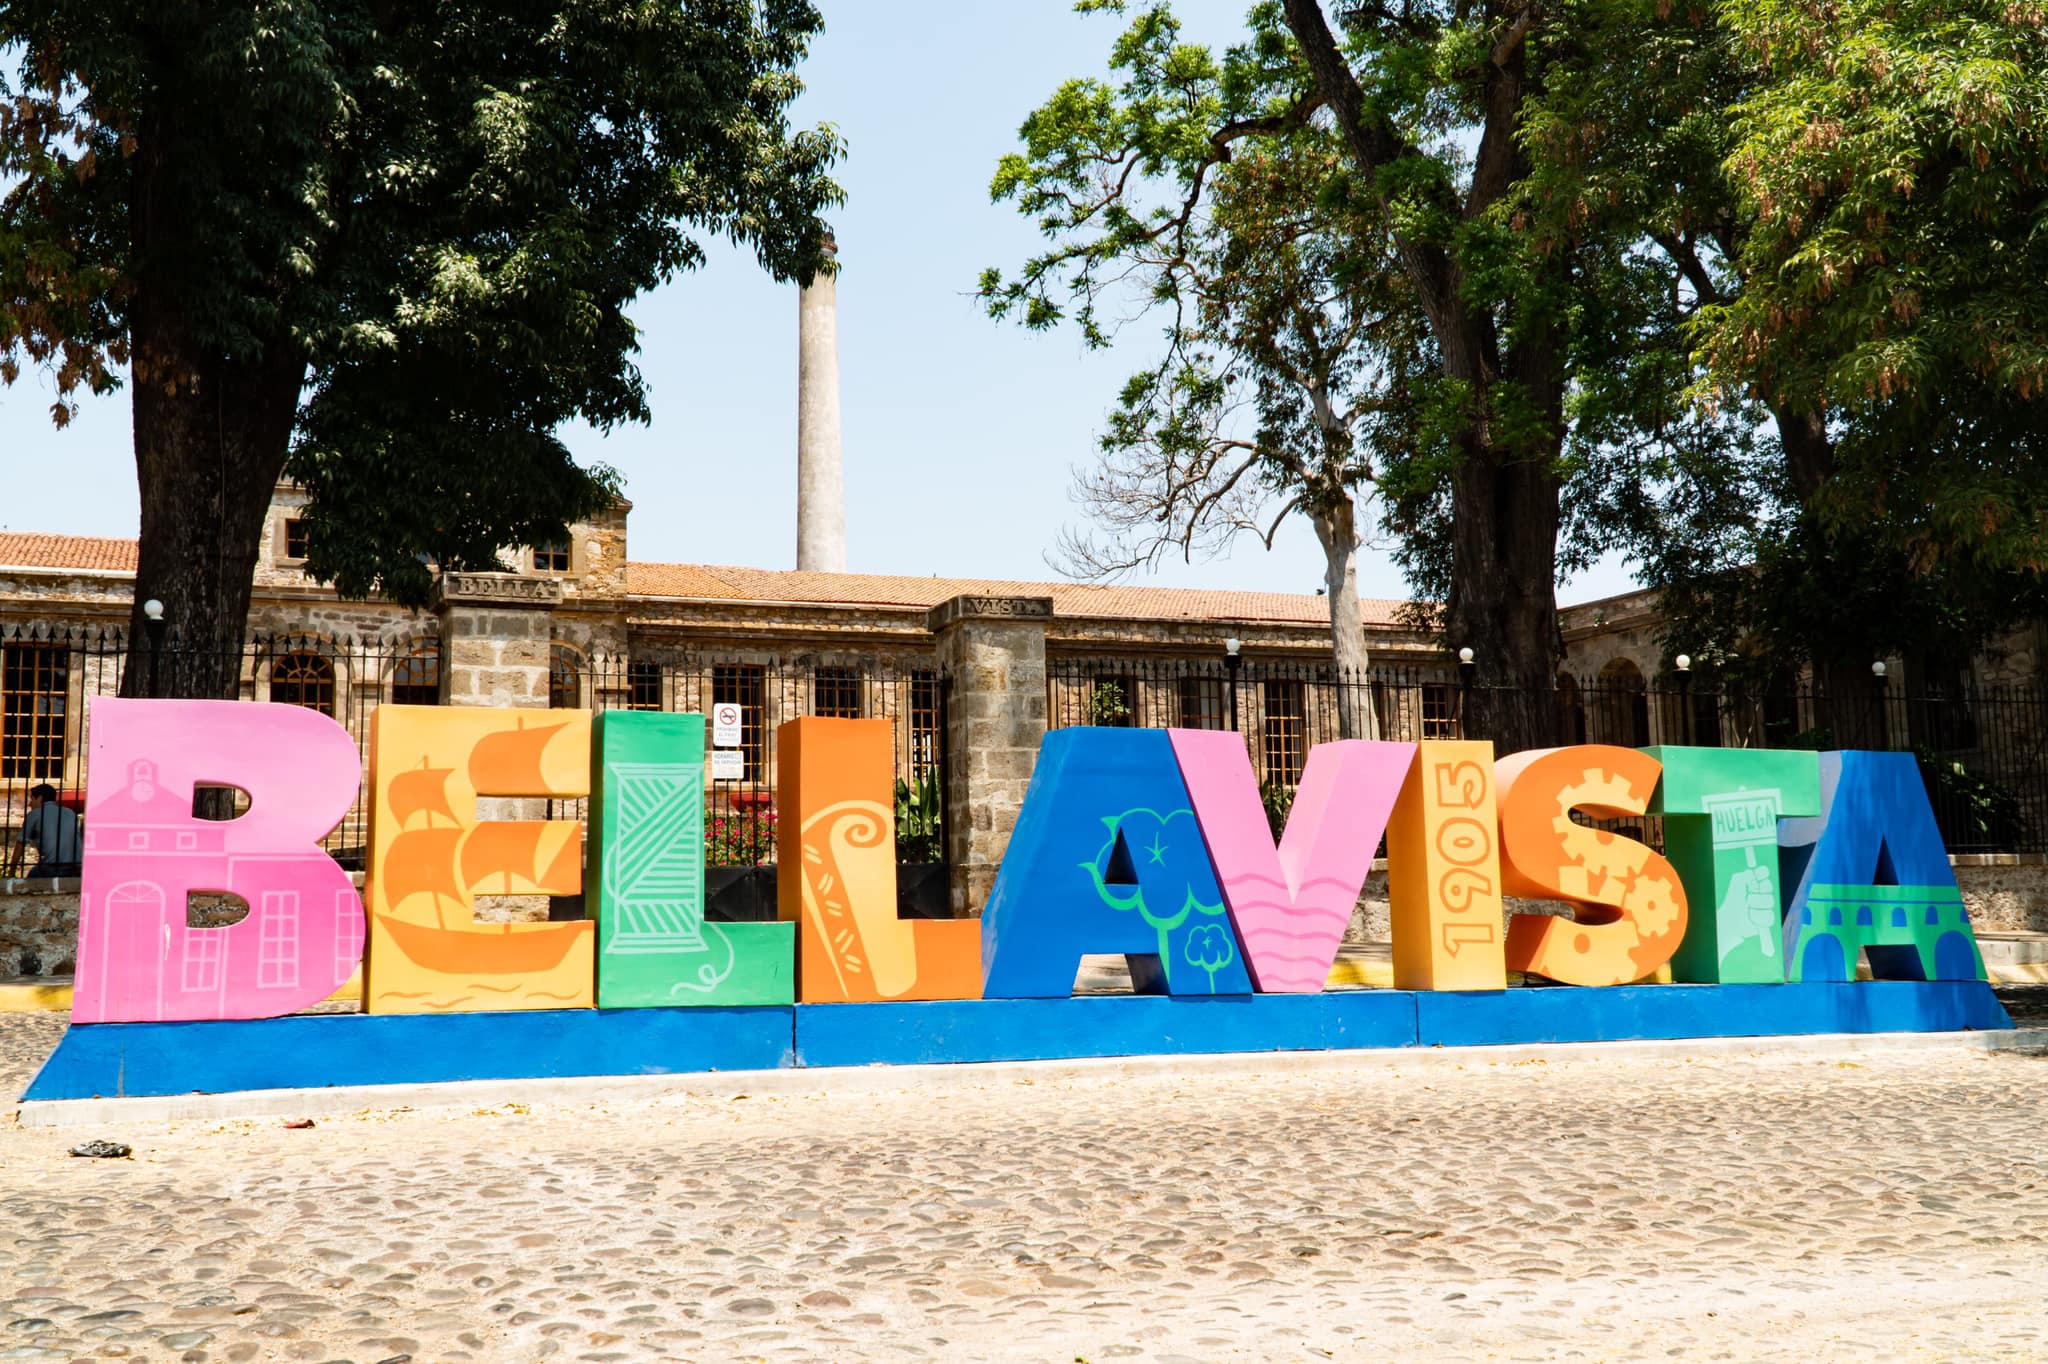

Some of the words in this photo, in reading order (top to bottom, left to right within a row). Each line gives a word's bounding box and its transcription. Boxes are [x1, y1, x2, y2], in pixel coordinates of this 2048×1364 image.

[458, 577, 551, 598] BELLA
[72, 696, 1987, 1023] BELLAVISTA
[1435, 760, 1494, 958] 1905
[1713, 805, 1774, 834] HUELGA
